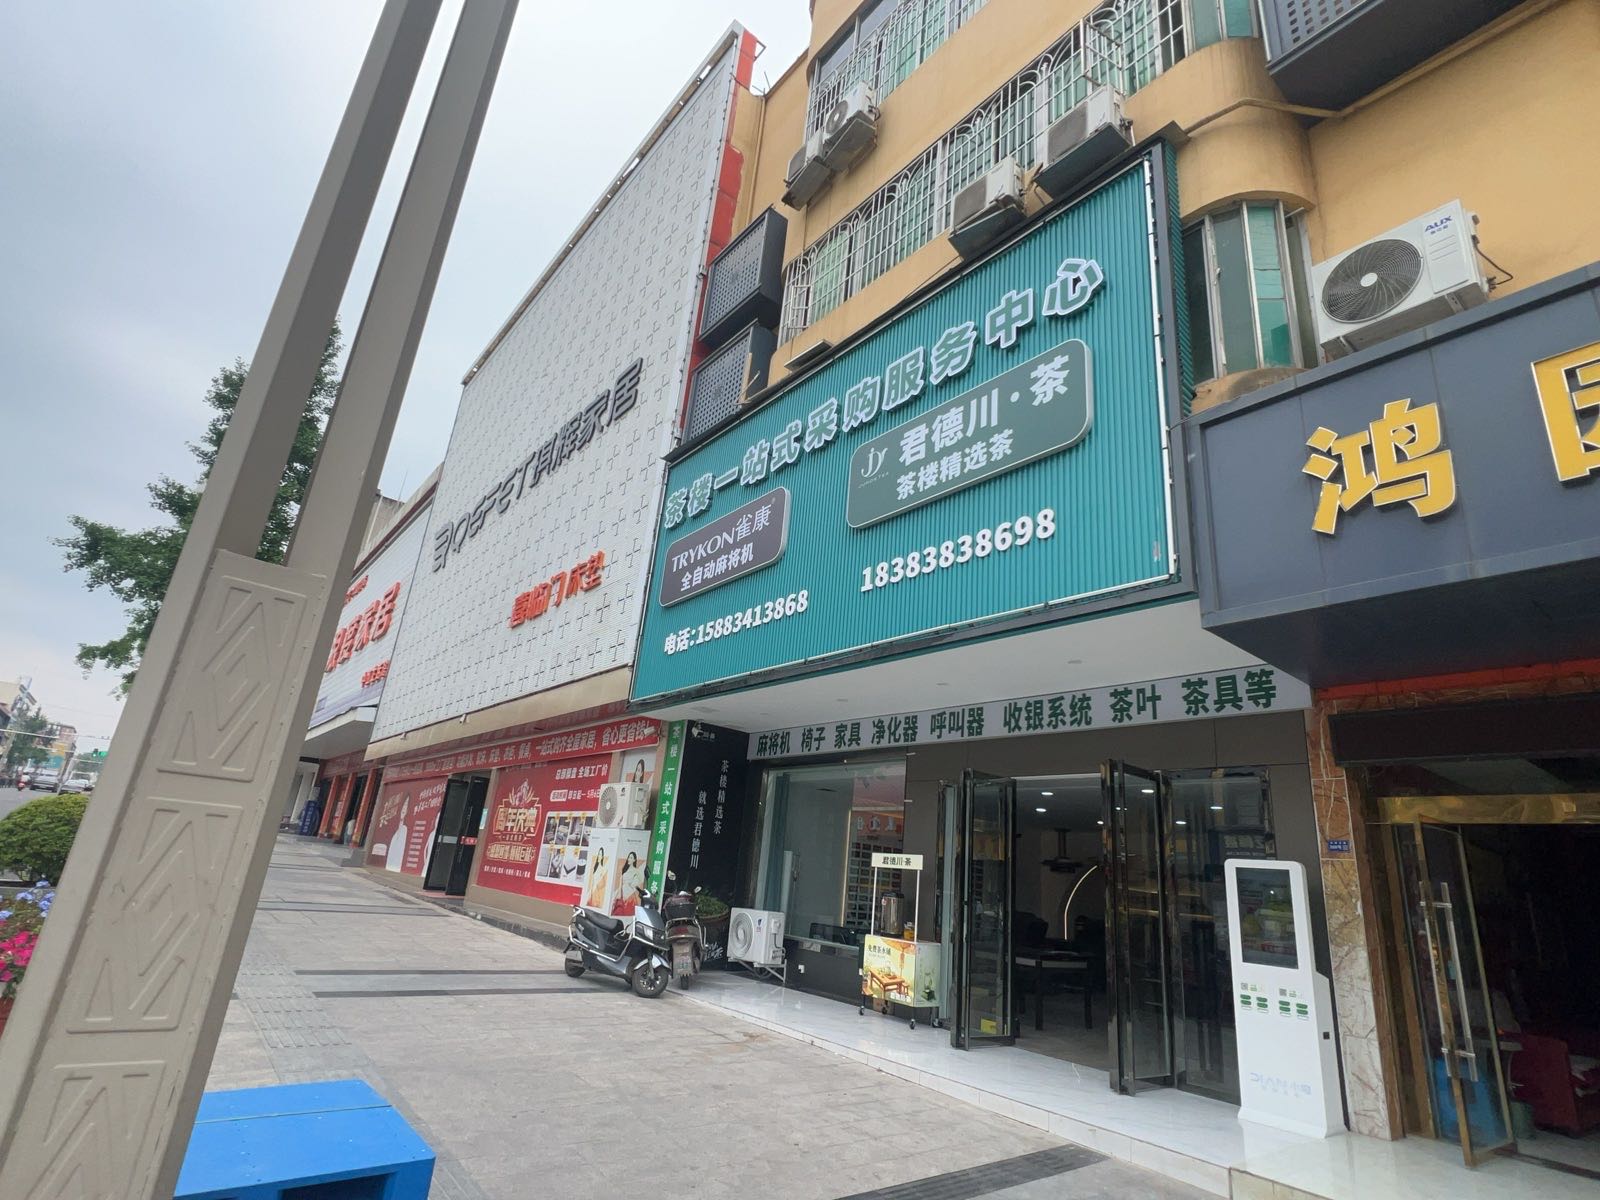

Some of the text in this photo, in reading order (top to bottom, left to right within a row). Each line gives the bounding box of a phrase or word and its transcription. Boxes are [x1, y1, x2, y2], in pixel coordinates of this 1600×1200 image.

[1424, 215, 1452, 233] AUX
[664, 258, 1104, 528] 茶楼一站式采购服务中心
[896, 429, 1013, 501] 茶楼精选茶
[681, 543, 753, 591] 全自动麻将机
[861, 508, 1056, 592] 18383838698
[757, 669, 1277, 757] 麻将机 椅子 家具 净化器 呼叫器 收银系统 茶叶 茶具等
